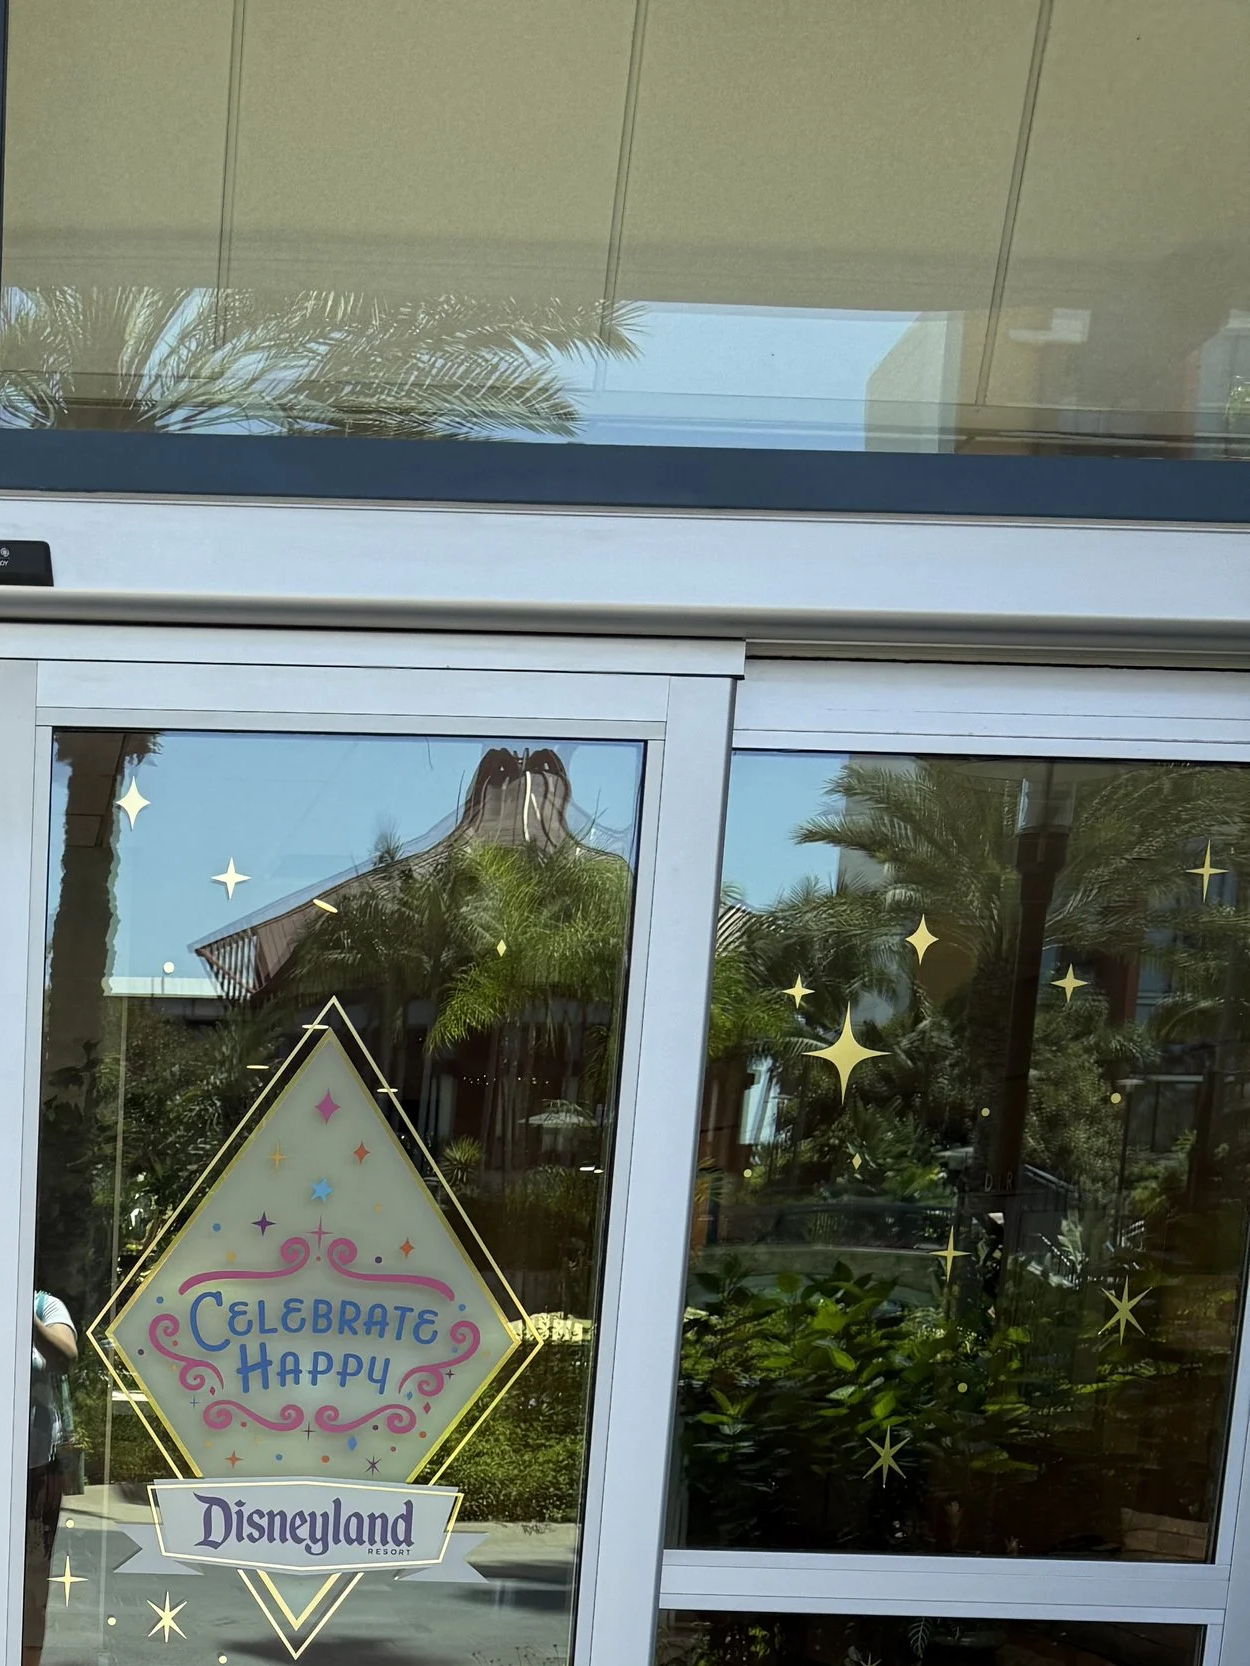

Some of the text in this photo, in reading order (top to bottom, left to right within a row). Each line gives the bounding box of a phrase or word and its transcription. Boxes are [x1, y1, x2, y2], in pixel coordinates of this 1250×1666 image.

[189, 1291, 439, 1353] CELEBRATE
[236, 1341, 391, 1395] HAPPY
[192, 1491, 415, 1557] Disneyland
[367, 1547, 411, 1556] RESORT
